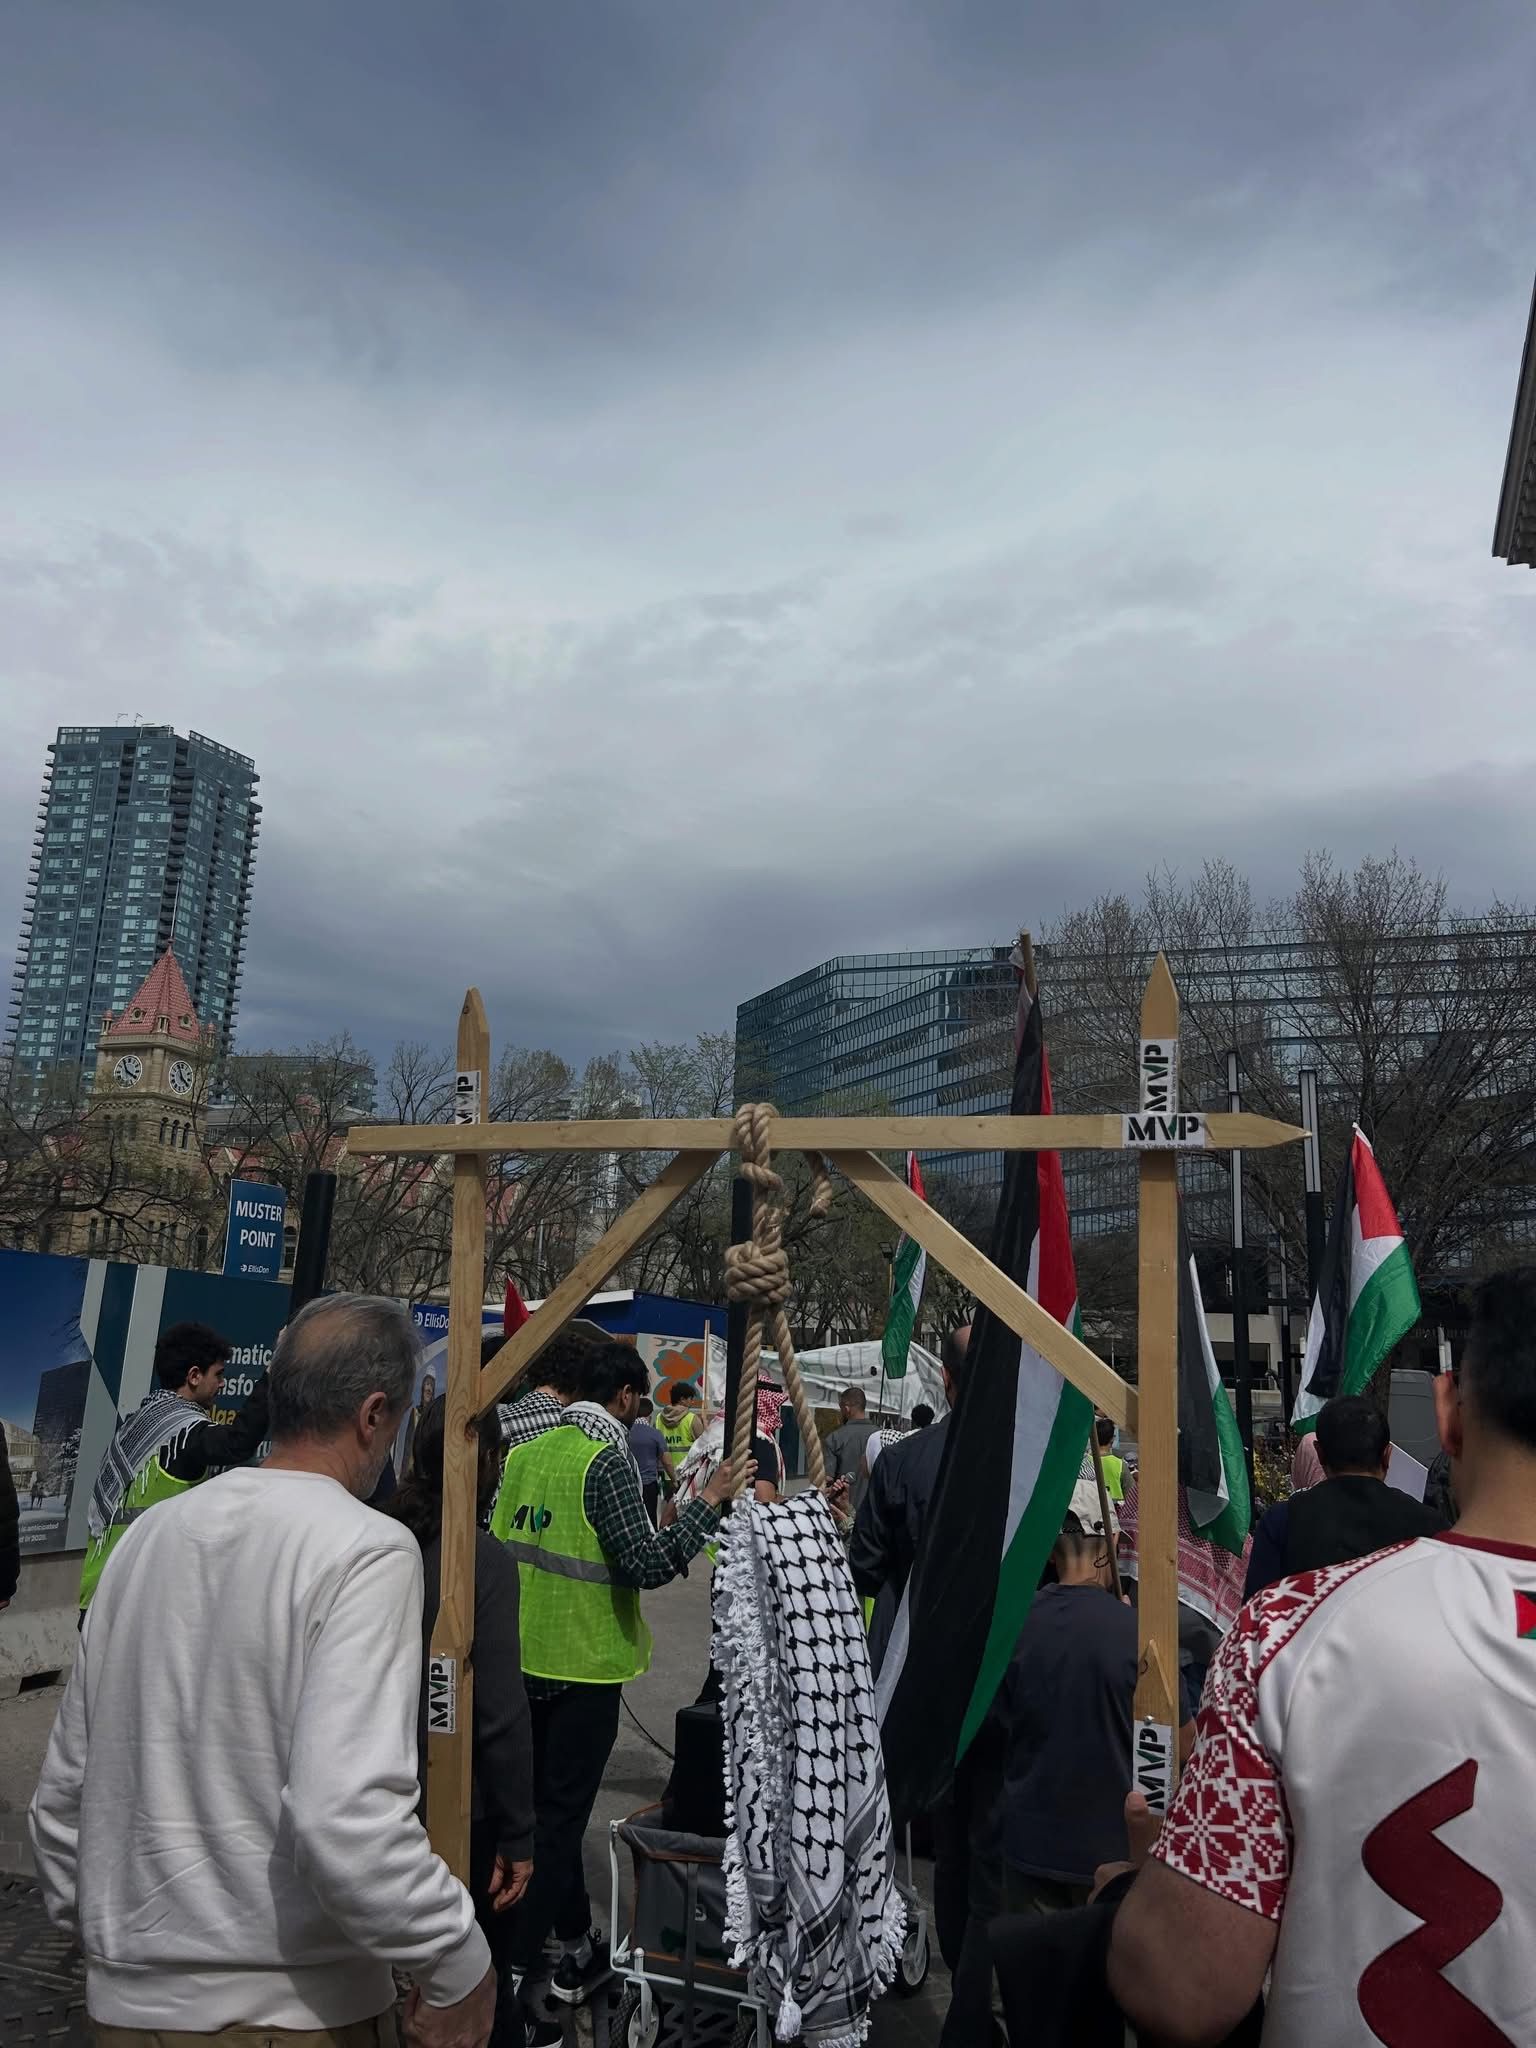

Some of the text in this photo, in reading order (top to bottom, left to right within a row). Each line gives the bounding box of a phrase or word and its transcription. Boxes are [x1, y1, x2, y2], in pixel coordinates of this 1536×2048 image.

[1142, 1044, 1169, 1112] MVP
[1128, 1115, 1199, 1141] MVP
[235, 1200, 282, 1222] MUSTER
[239, 1229, 276, 1248] POINT
[424, 1312, 449, 1328] EllisDo
[430, 1662, 449, 1728] MVP
[1136, 1728, 1166, 1810] MVP
